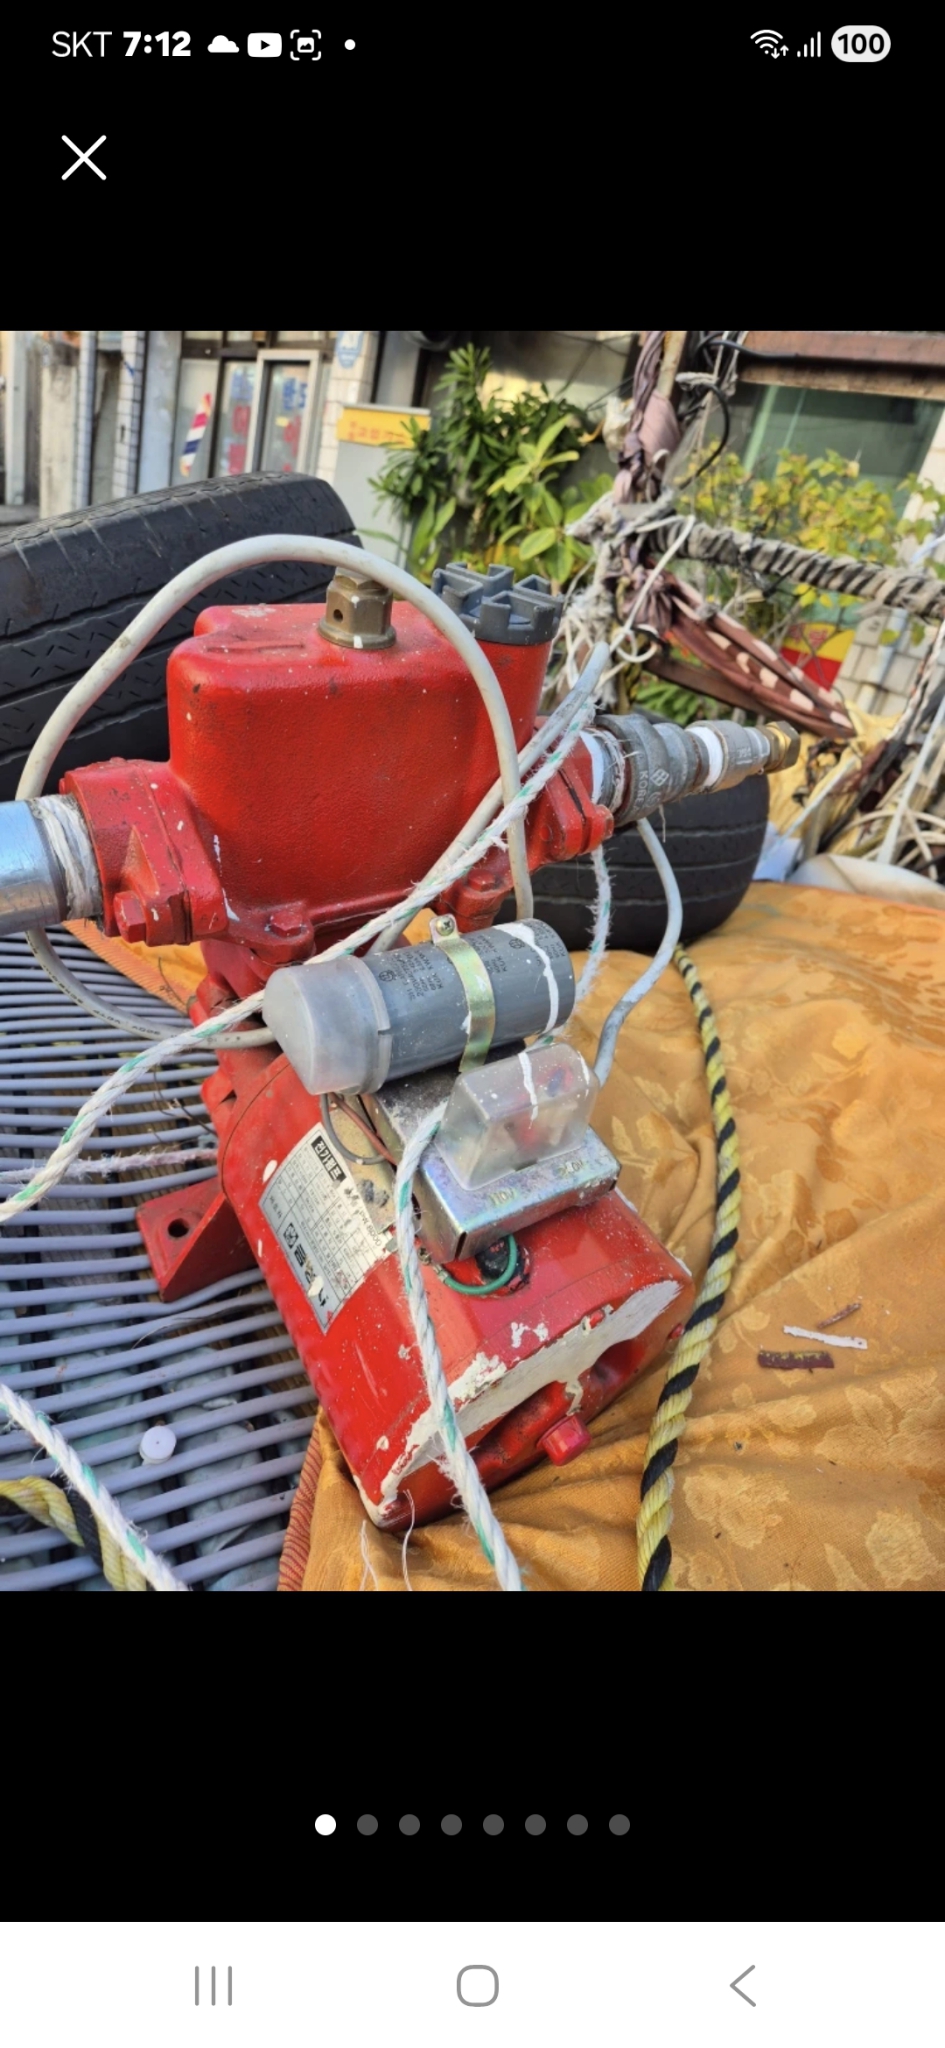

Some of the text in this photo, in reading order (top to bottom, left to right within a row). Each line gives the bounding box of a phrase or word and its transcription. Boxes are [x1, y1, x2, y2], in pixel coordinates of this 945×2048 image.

[632, 770, 649, 811] KOREA
[314, 1142, 341, 1181] 전기펌프
[558, 1159, 584, 1178] 20V
